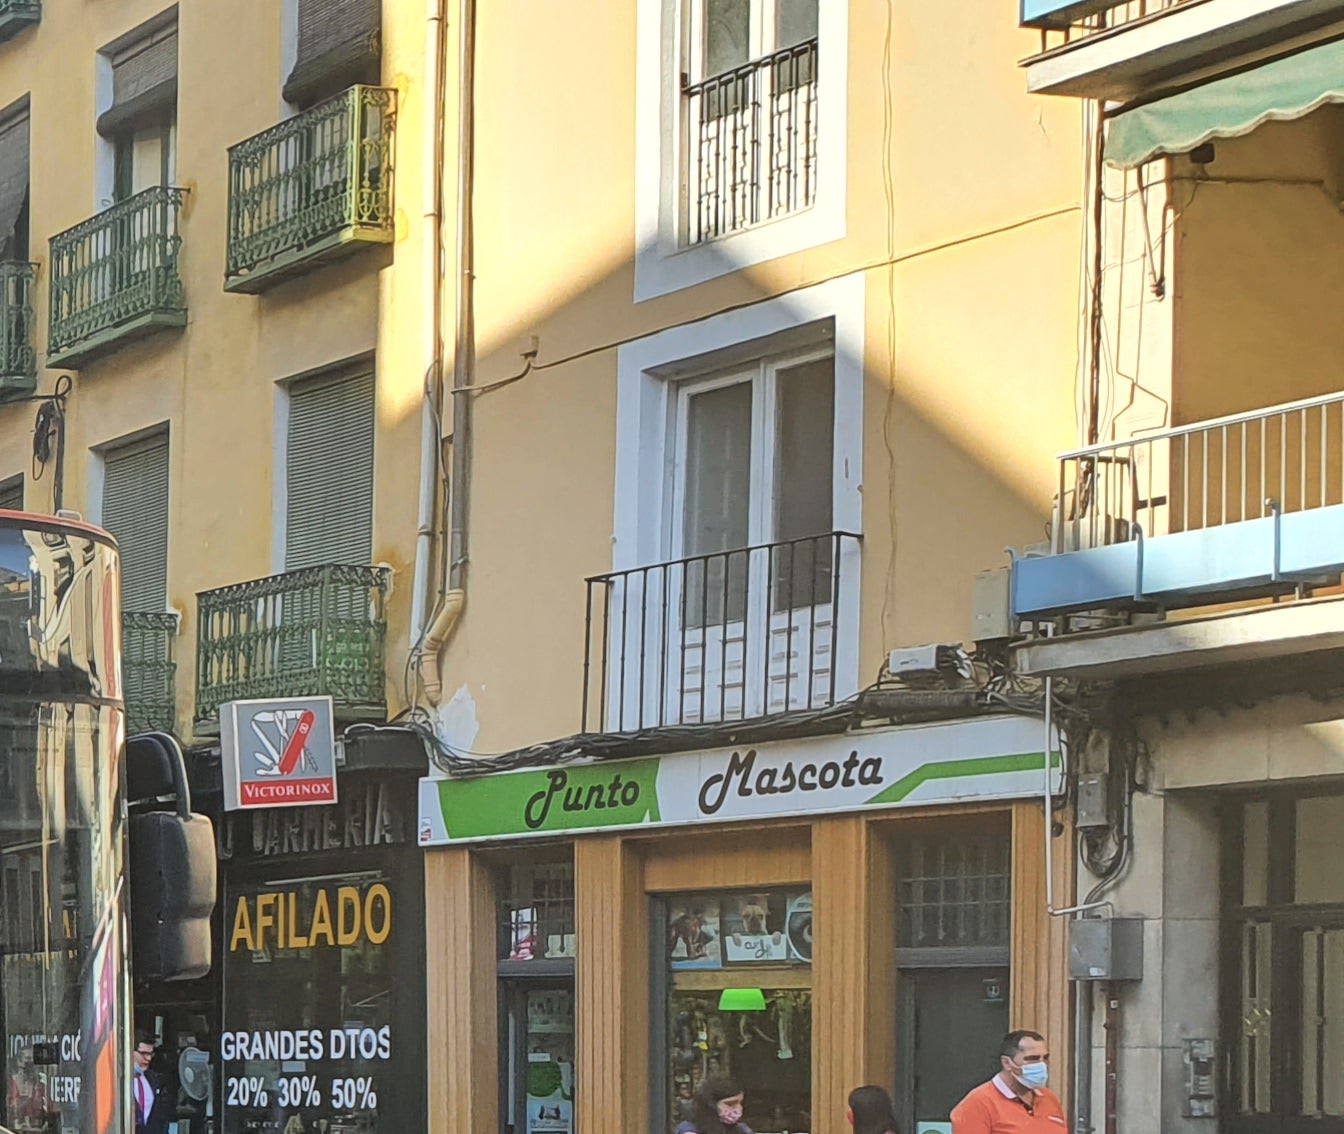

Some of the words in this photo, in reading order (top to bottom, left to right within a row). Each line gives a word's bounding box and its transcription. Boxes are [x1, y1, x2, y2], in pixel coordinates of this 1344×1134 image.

[244, 783, 330, 798] VICTORINOX
[524, 770, 640, 829] Punto
[698, 750, 884, 815] Mascota
[230, 883, 391, 951] AFILADO
[221, 1030, 323, 1060] GRANDES
[330, 1026, 390, 1060] DTOS
[227, 1077, 268, 1107] 20%
[278, 1075, 321, 1107] 30%
[331, 1077, 377, 1109] 50%
